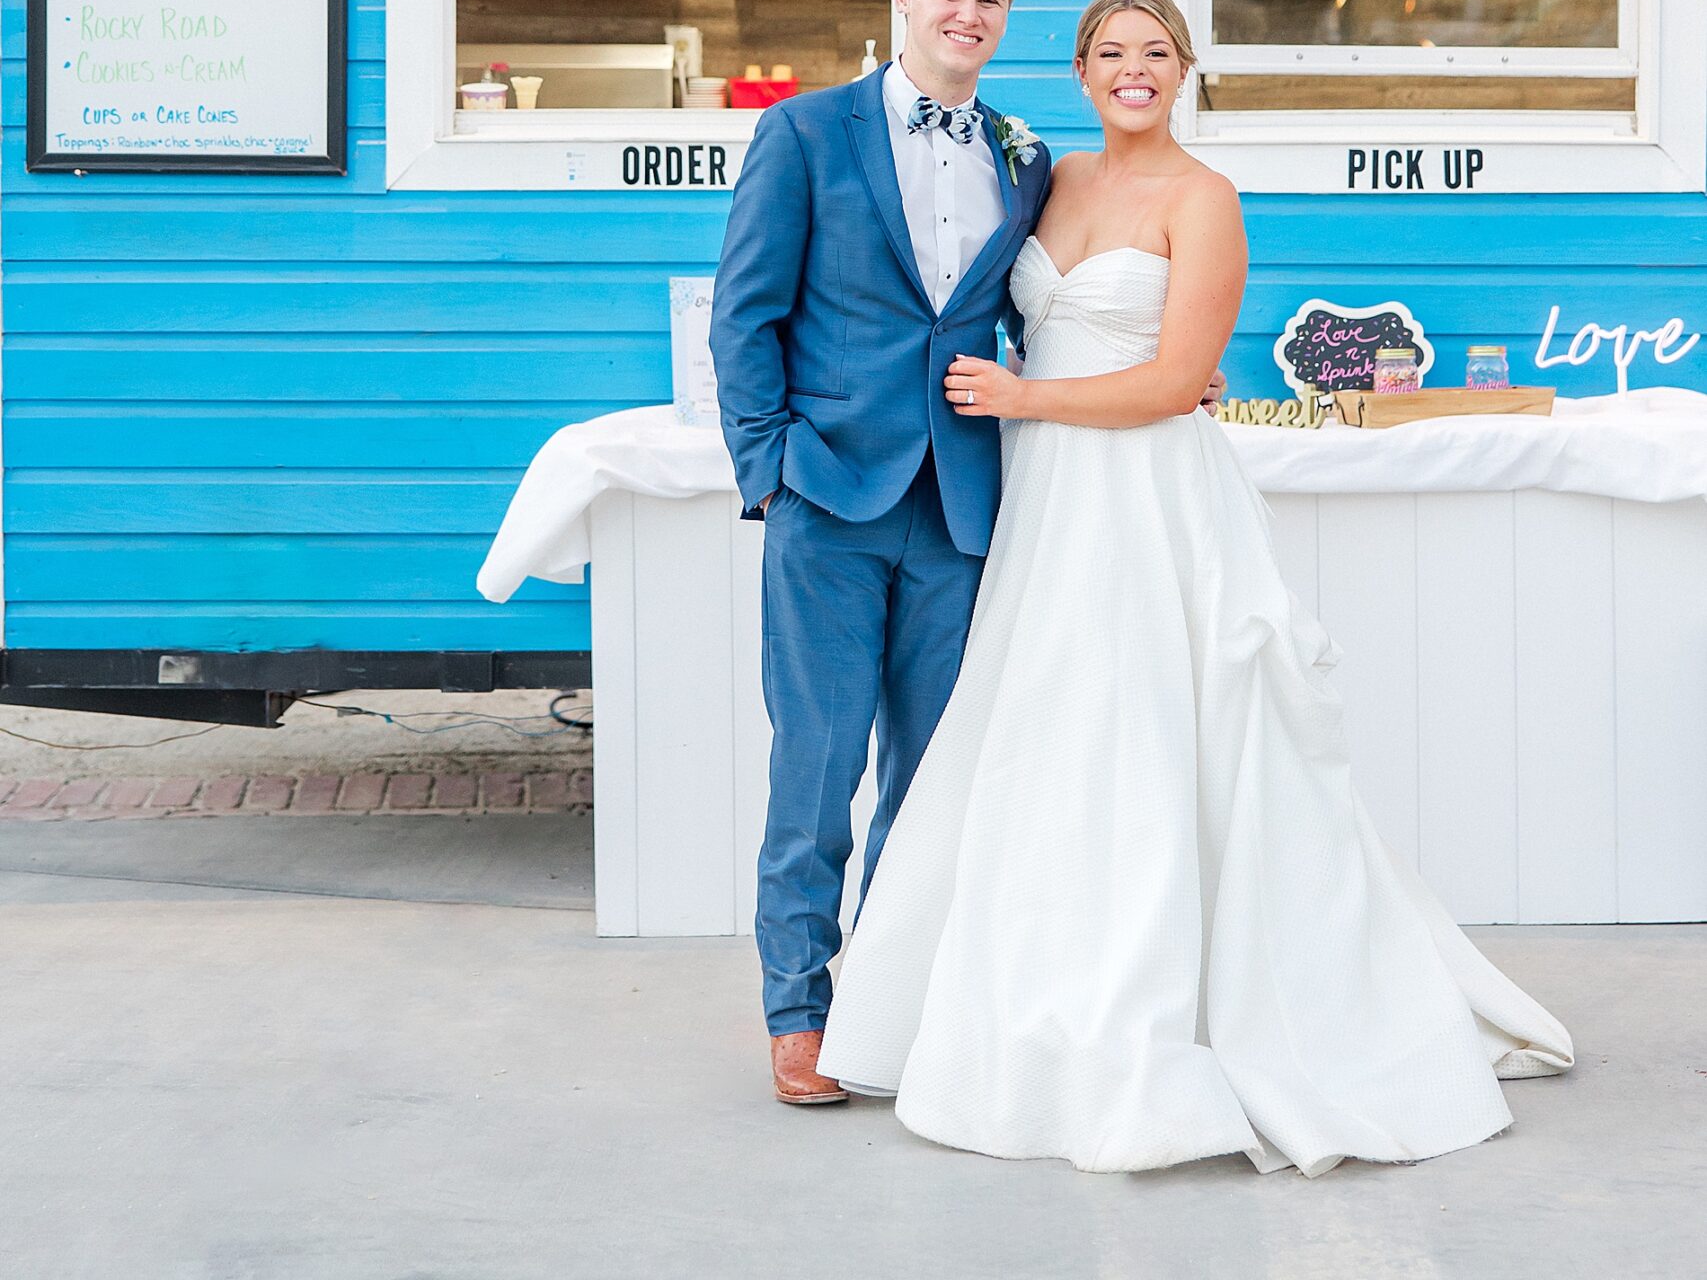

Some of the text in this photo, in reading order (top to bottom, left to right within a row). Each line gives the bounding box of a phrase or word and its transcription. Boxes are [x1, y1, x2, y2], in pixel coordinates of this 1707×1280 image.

[81, 5, 228, 41] ROCKY ROAD
[77, 51, 155, 84] COOKIES
[181, 55, 247, 83] CREAM
[83, 107, 121, 125] CUPS
[157, 105, 190, 124] CAKE
[197, 105, 239, 124] CONES
[623, 145, 727, 185] ORDER
[1348, 149, 1484, 190] PICK UP
[1312, 319, 1381, 347] Love
[1534, 305, 1701, 368] Love
[1317, 357, 1375, 386] Sprink
